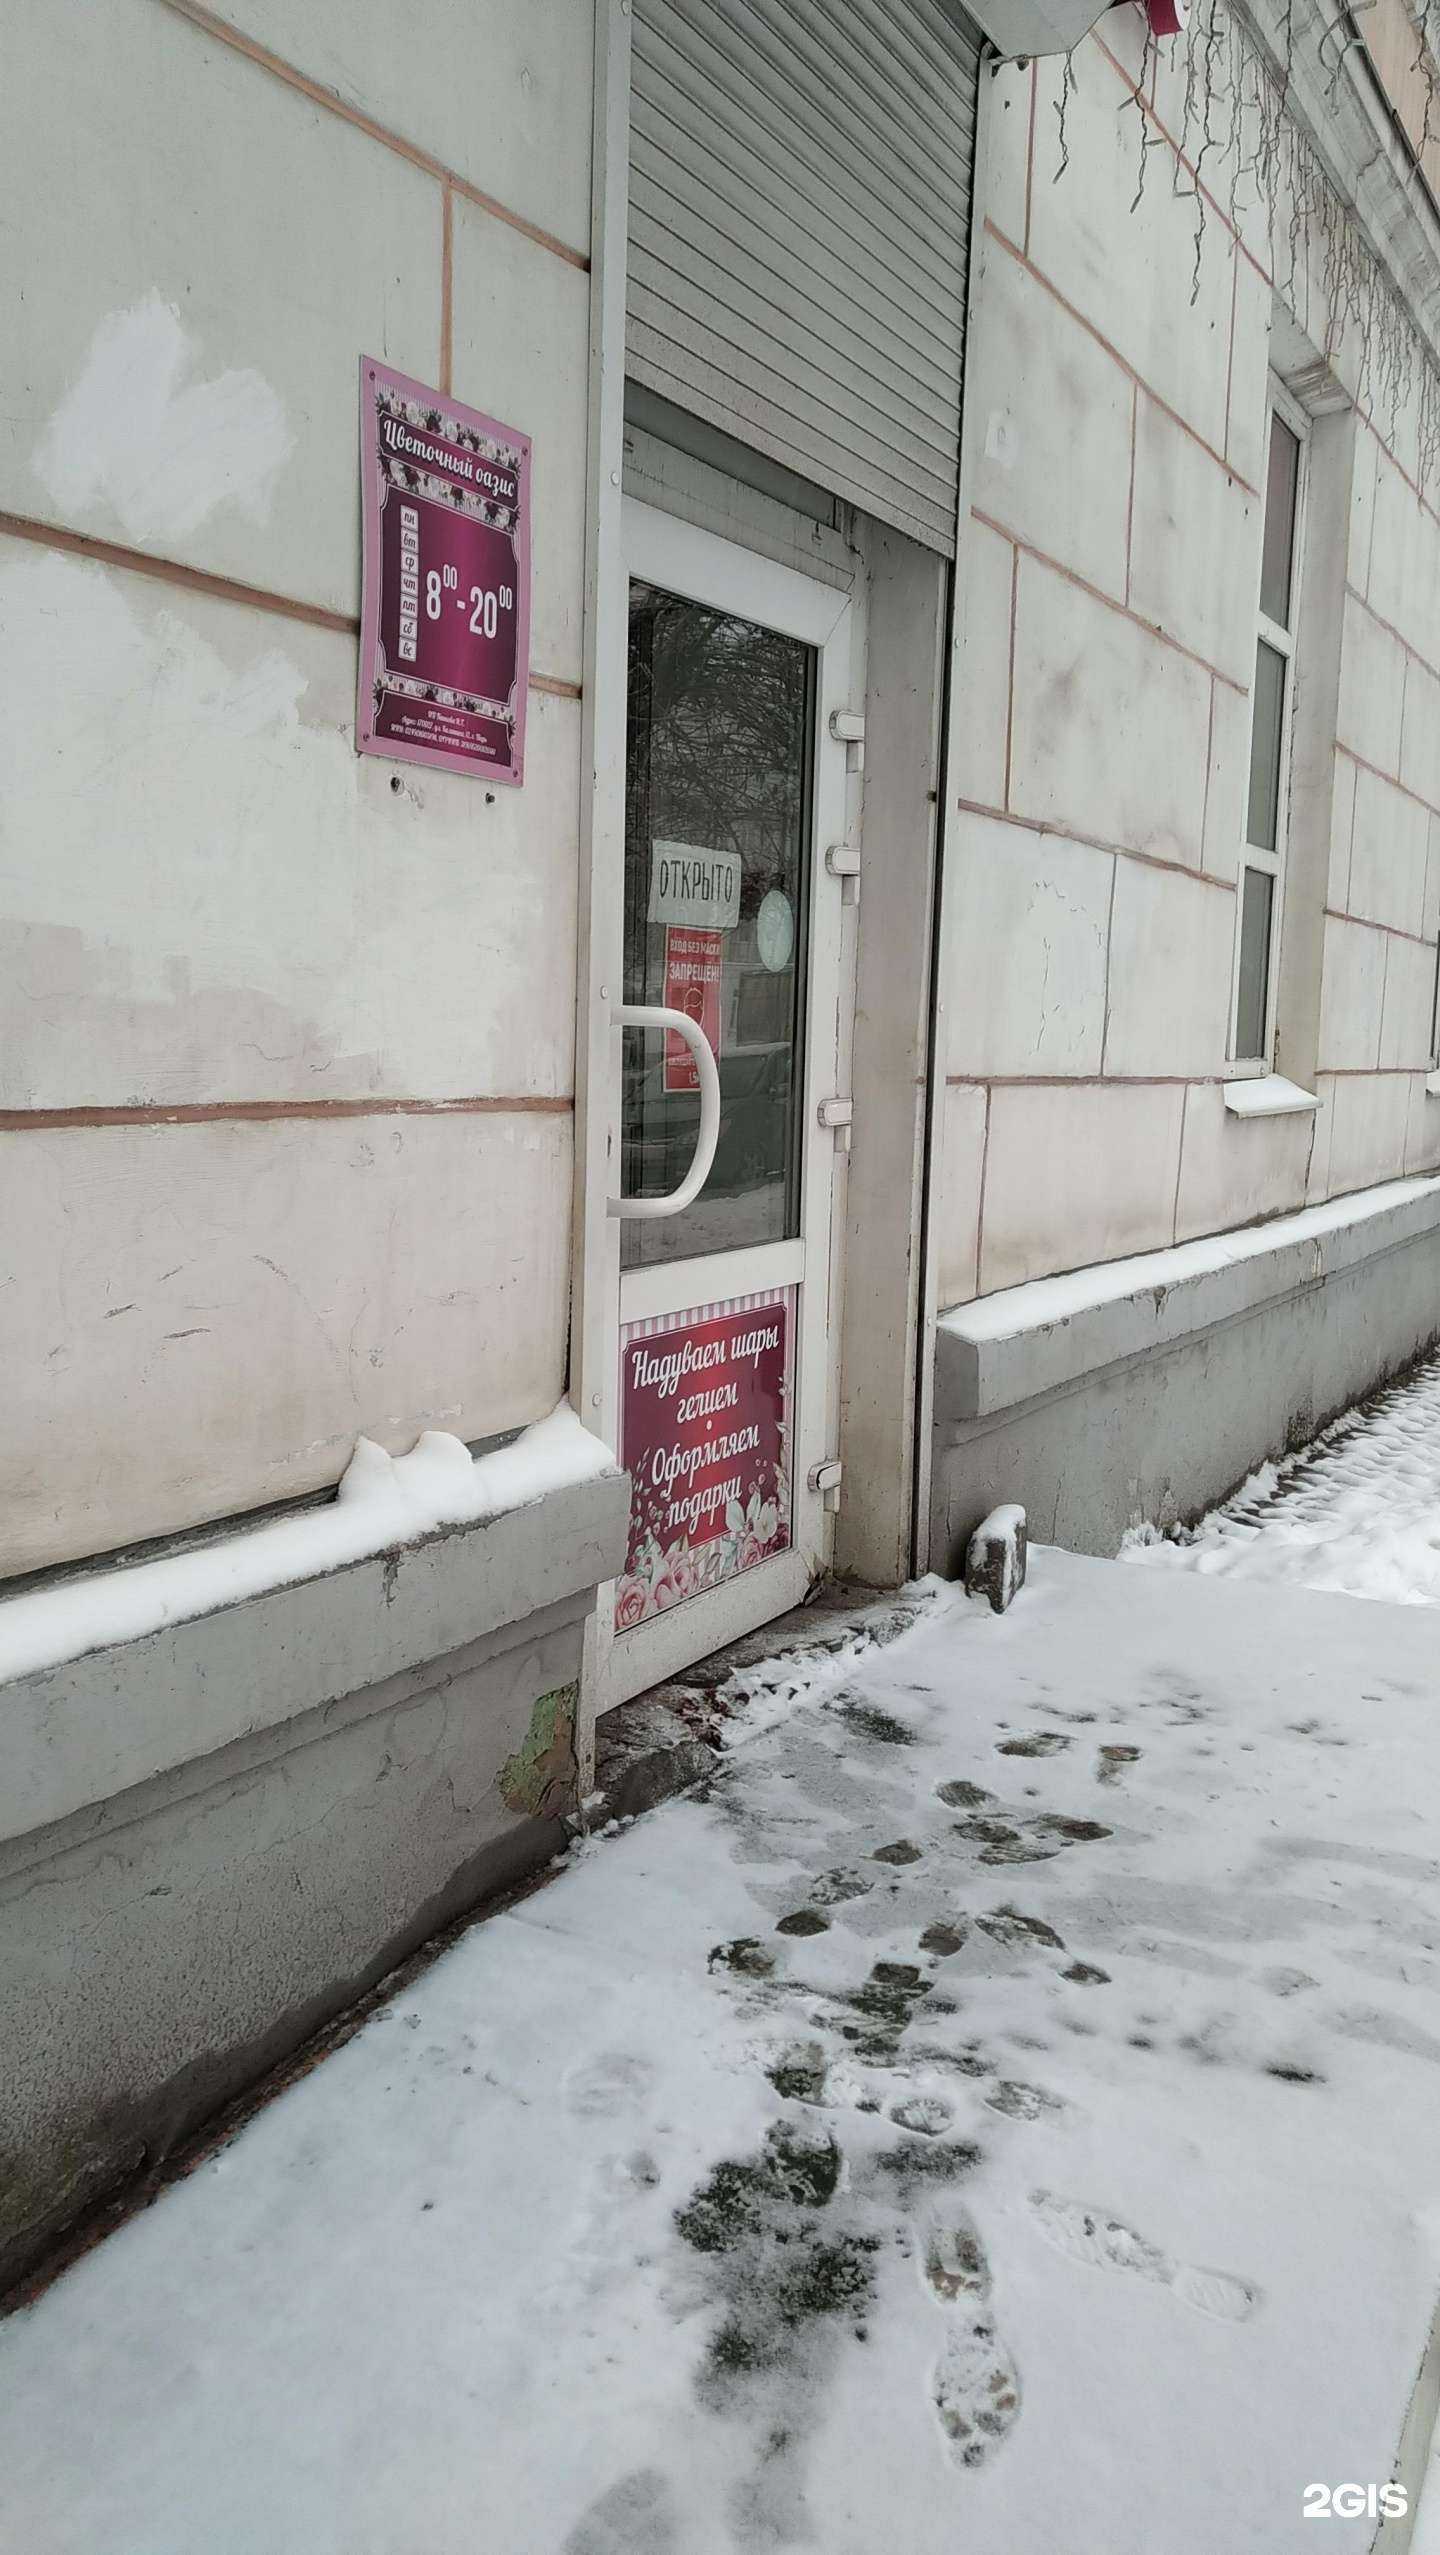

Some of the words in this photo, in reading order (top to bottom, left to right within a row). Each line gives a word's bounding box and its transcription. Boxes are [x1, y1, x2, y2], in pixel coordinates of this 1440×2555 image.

[384, 420, 473, 479] Цветочный
[475, 467, 515, 497] оазис
[404, 512, 415, 525] пн
[403, 534, 416, 548] вт
[405, 557, 415, 570] ср
[403, 578, 416, 590] чт
[403, 600, 416, 612] пт
[403, 622, 414, 634] сб
[403, 642, 412, 656] вс
[660, 860, 733, 902] ОТКРЫТО
[670, 939, 687, 954] ВХОД
[632, 1340, 727, 1399] Надуваем
[731, 1325, 779, 1368] шары
[677, 1382, 738, 1423] гелием
[652, 1424, 760, 1497] Оформляем
[668, 1475, 742, 1535] подарки
